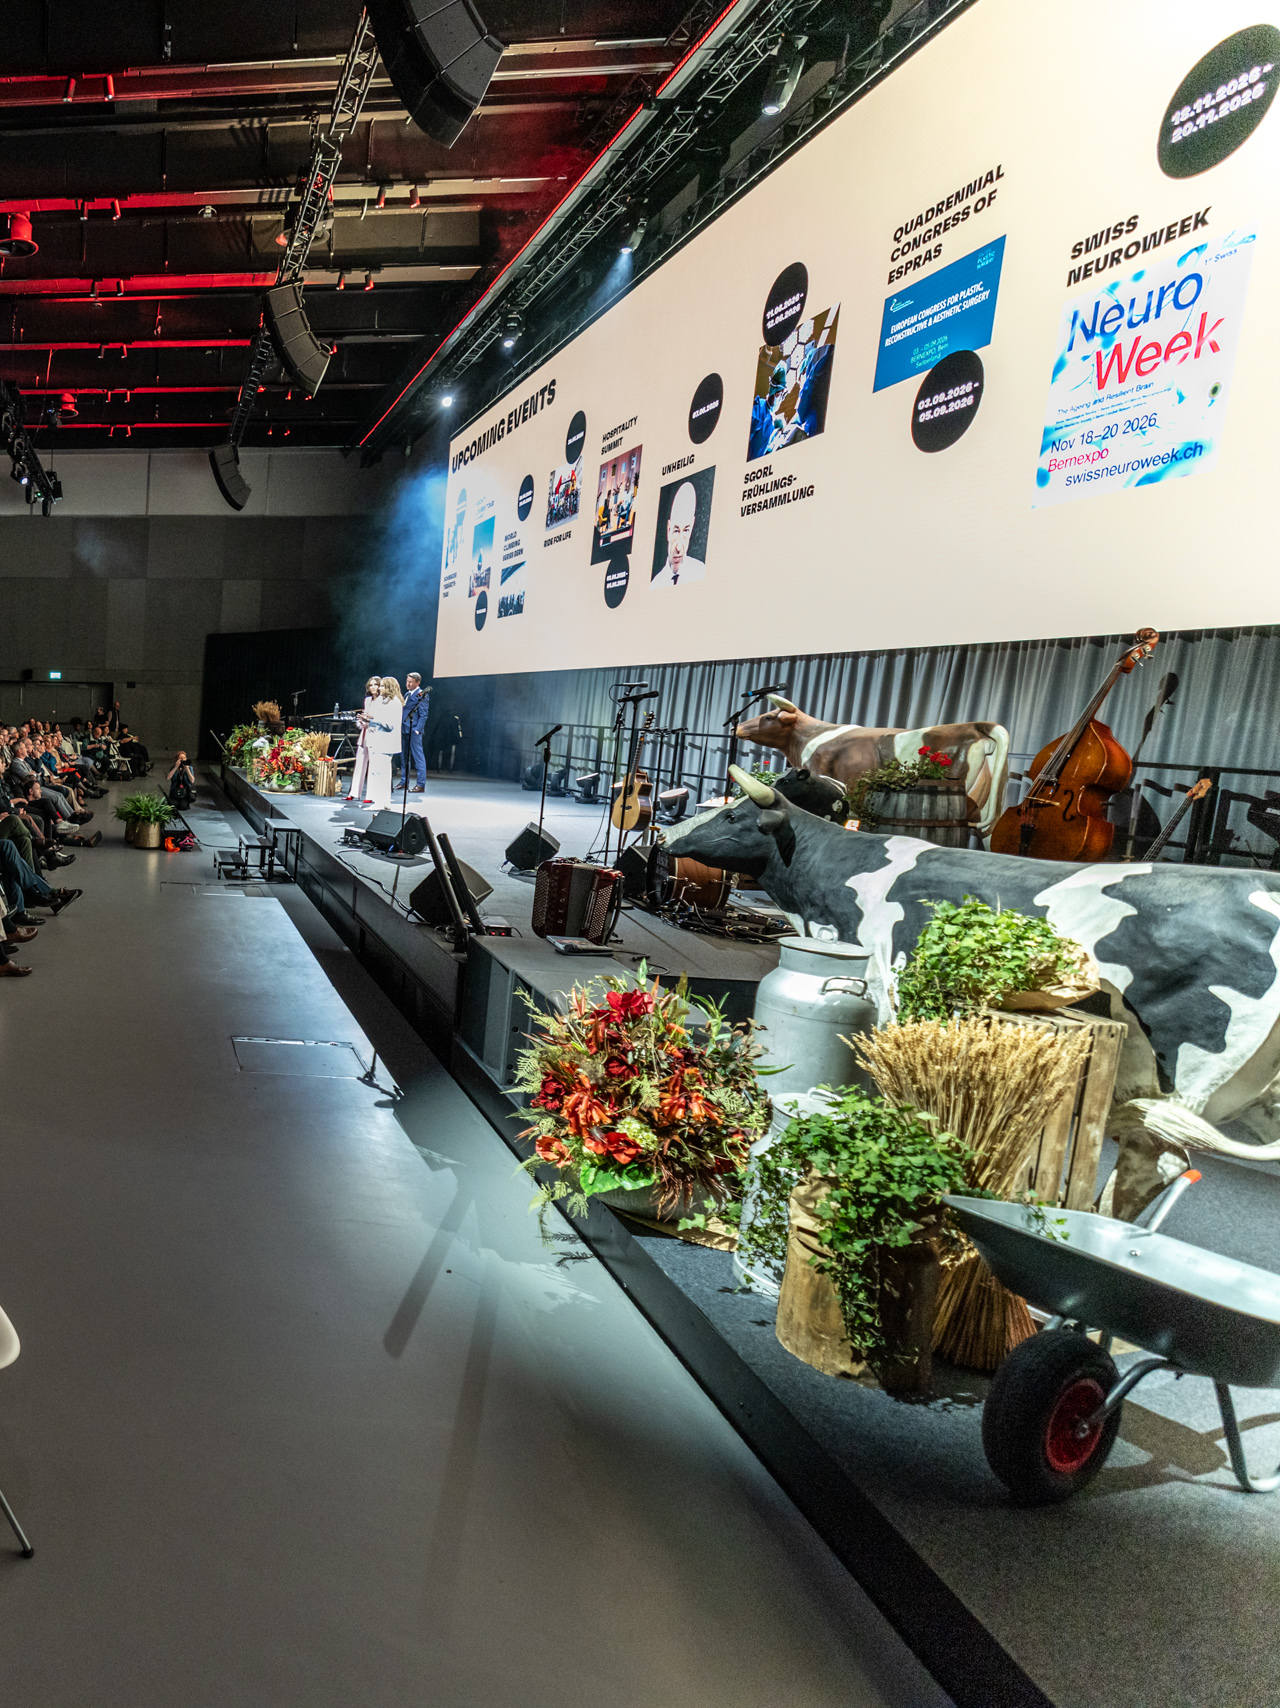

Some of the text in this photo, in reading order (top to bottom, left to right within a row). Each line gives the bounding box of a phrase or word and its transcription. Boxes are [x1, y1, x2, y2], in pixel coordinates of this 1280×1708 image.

[1171, 66, 1262, 124] 18.11.2026
[1171, 82, 1265, 143] 20.11.2026
[893, 164, 1005, 244] QUADRENNIAL
[890, 189, 998, 262] CONGRESS OF
[1070, 214, 1139, 260] SWISS
[887, 243, 943, 286] ESPRAS
[1066, 206, 1212, 288] NEUROWEEK
[884, 320, 928, 348] RECONSTRUCTIVE
[933, 306, 962, 325] AESTHETIC
[962, 289, 990, 312] SURGERY
[890, 314, 918, 334] EUROPEAN
[918, 302, 947, 321] CONGRESS
[947, 296, 959, 306] FOR
[1066, 272, 1203, 352] Neuro
[1095, 311, 1225, 391] Week
[918, 382, 974, 411] 03.09.2026
[918, 396, 974, 423] 05.09.2026
[1092, 396, 1105, 406] and
[1106, 386, 1134, 400] Resilient
[1136, 382, 1154, 392] Brain
[452, 379, 557, 474] UPCOMING EVENTS
[601, 437, 624, 456] SUMMIT
[602, 416, 638, 443] HOSPITALITY
[1051, 437, 1076, 454] Nov
[1122, 412, 1157, 438] 2026
[662, 454, 695, 476] UNHEILIG
[744, 464, 774, 484] SGORL
[1048, 448, 1109, 472] Bernexpo
[1065, 442, 1203, 486] swissneuroweek.ch
[740, 484, 815, 518] VERSAMMLUNG
[742, 474, 798, 502] FRÜHLINGS-
[554, 535, 562, 545] FOR
[563, 530, 572, 542] LIFE
